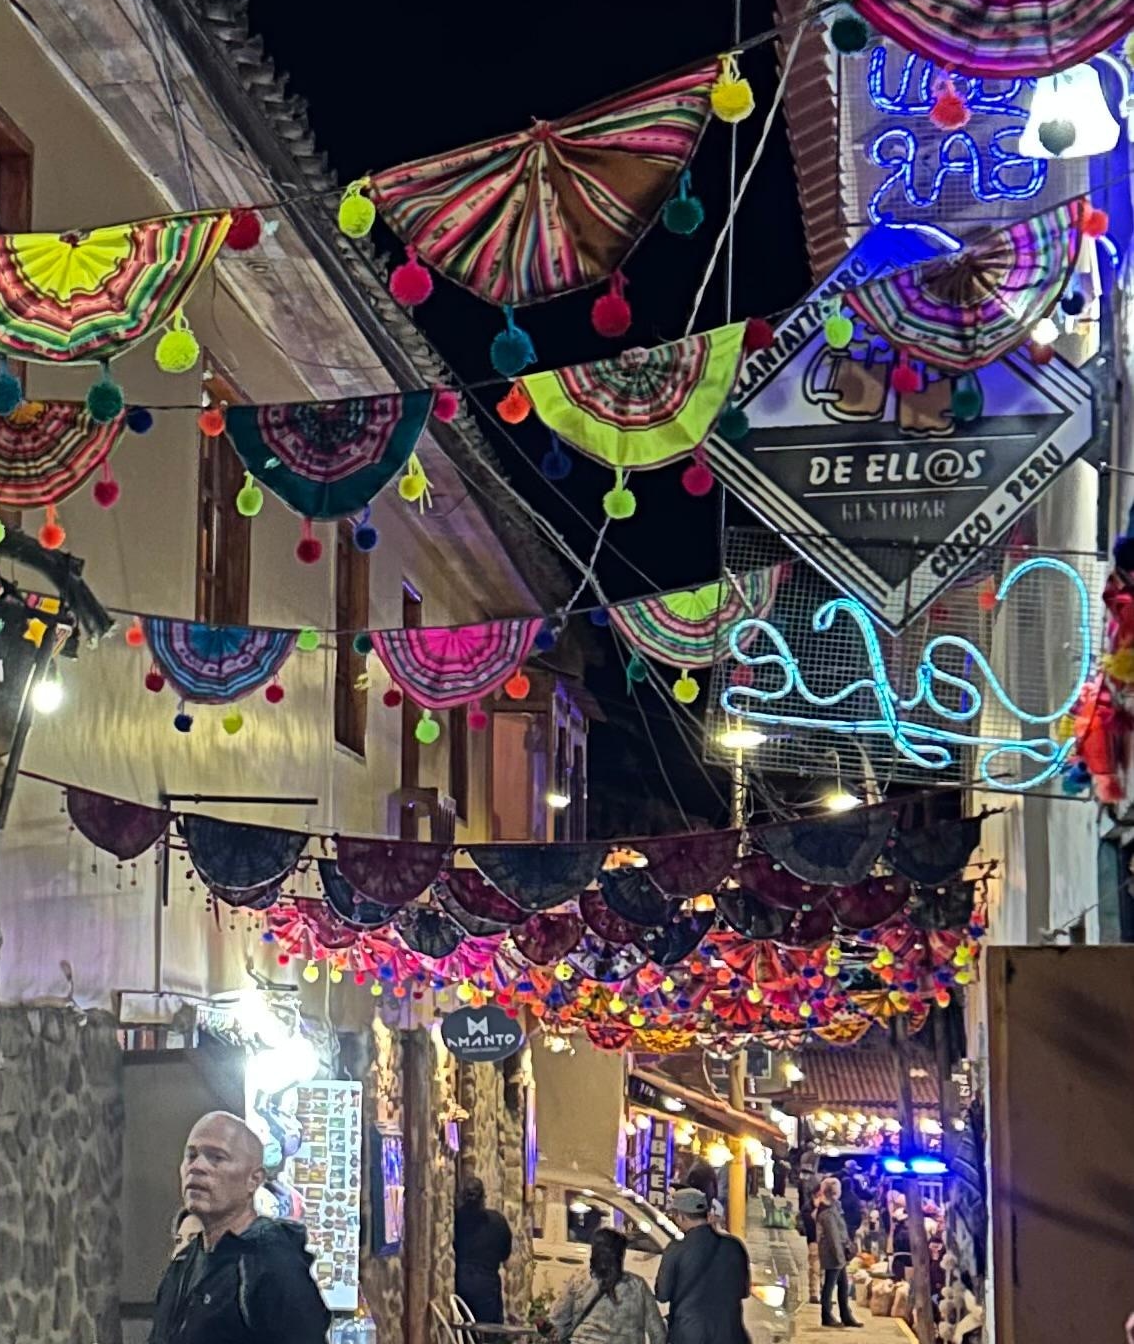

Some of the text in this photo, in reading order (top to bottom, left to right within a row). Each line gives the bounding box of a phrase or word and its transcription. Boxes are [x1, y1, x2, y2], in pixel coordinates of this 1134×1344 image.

[808, 448, 987, 485] DE ELL@S
[841, 499, 946, 522] RESTOBAR
[930, 512, 993, 578] CUSCO
[1004, 441, 1065, 502] PERU
